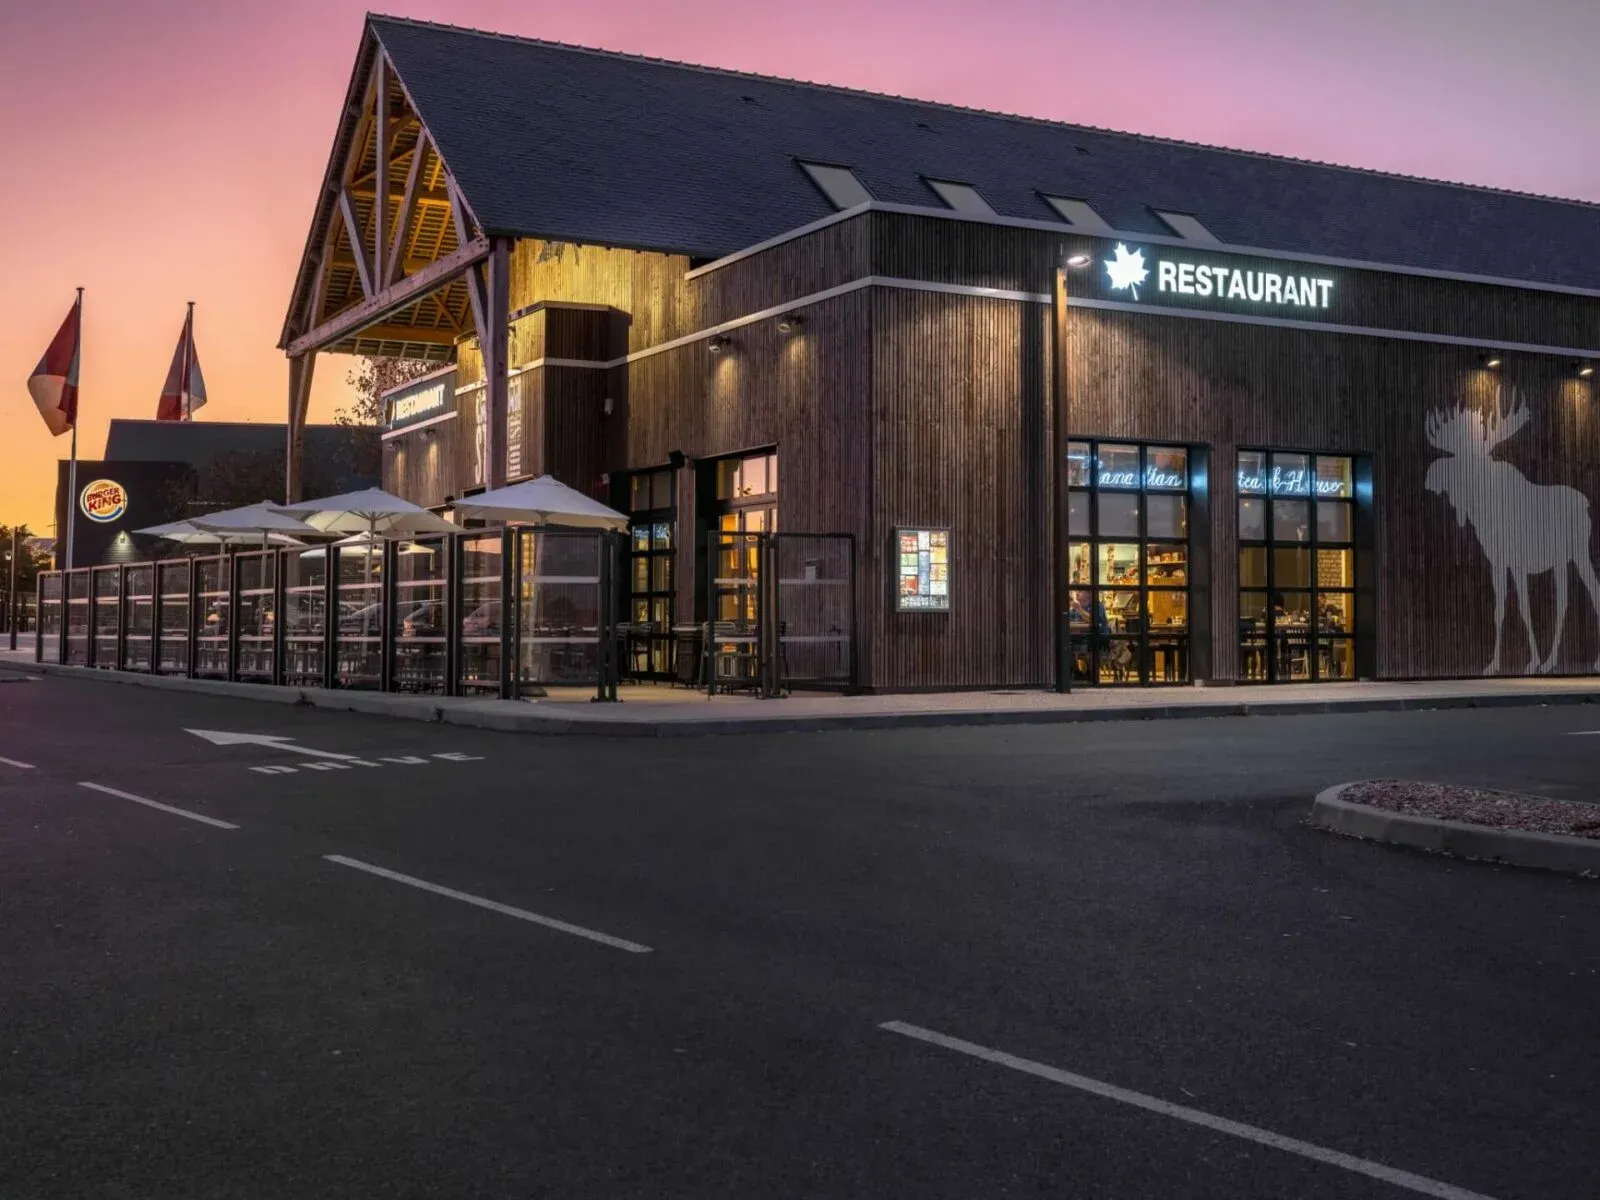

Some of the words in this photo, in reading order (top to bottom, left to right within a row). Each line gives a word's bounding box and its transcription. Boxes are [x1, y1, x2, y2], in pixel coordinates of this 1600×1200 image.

[1158, 260, 1334, 308] RESTAURANT
[87, 488, 120, 502] BURGER
[88, 495, 121, 513] KING
